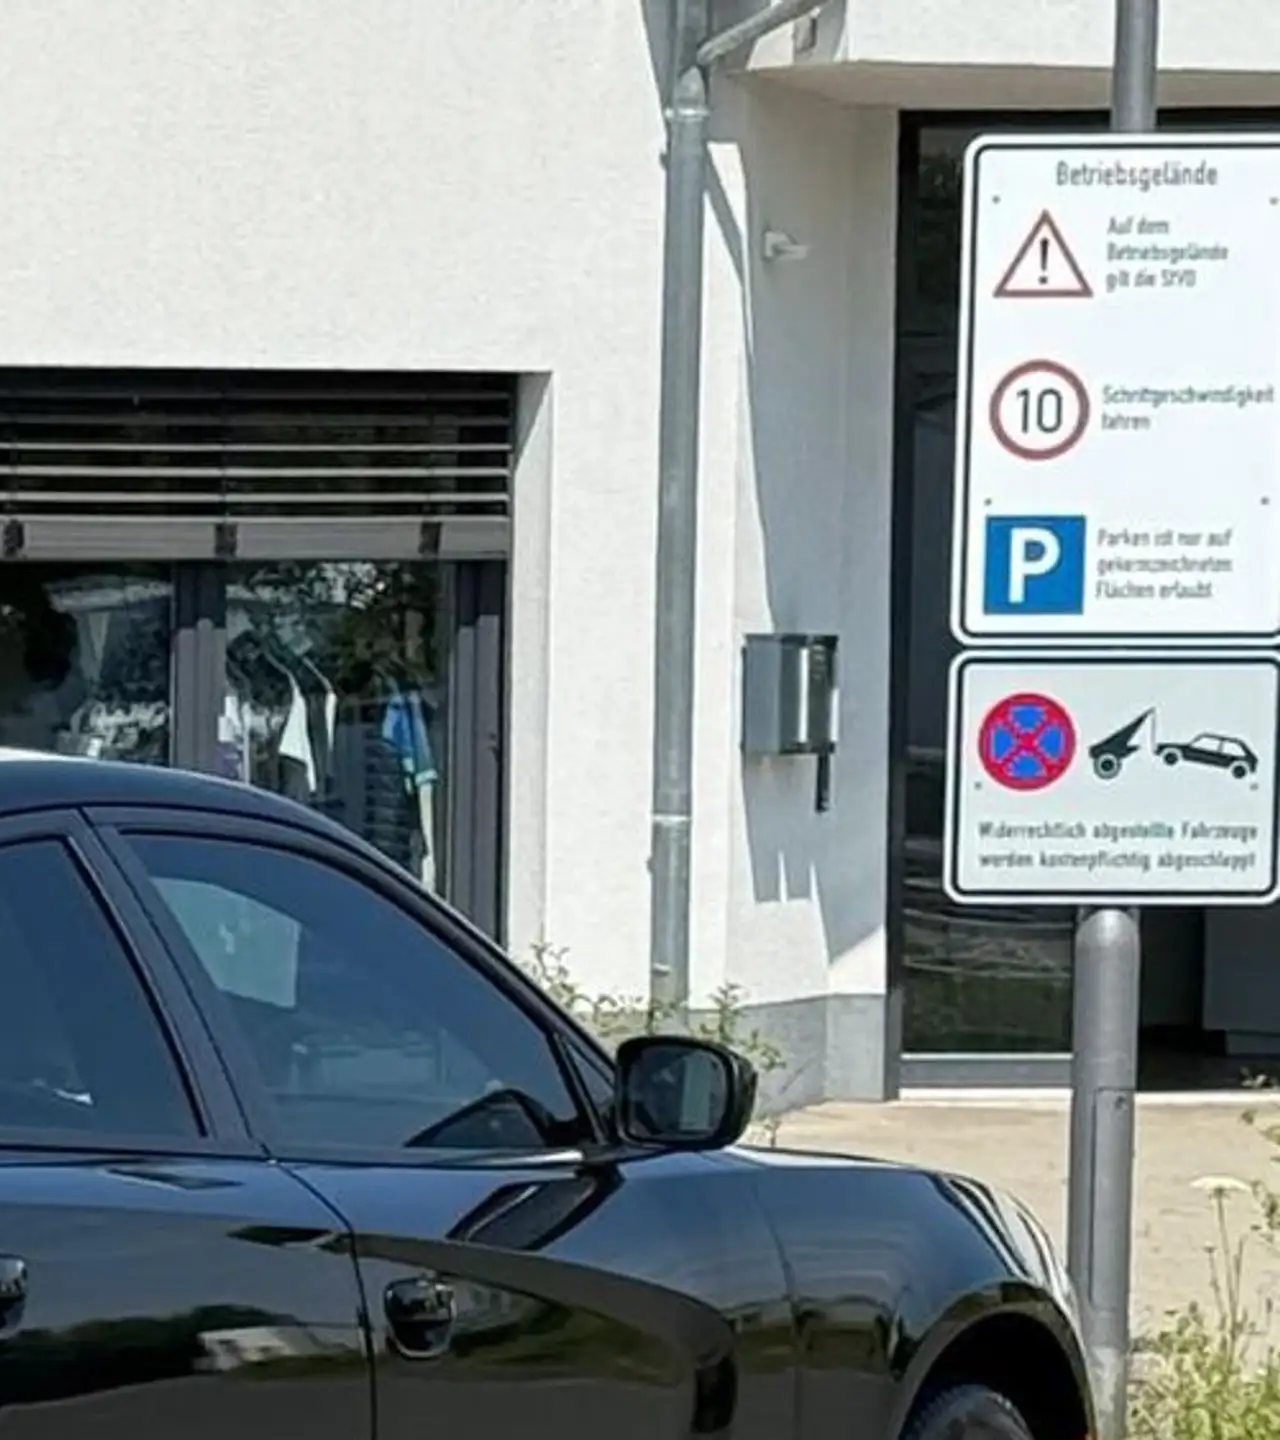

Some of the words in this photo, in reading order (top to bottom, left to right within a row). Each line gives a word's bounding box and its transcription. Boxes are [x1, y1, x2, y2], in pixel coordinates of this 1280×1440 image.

[1056, 160, 1218, 192] Betriebsgelände
[1017, 387, 1064, 434] 10
[1008, 527, 1060, 604] P
